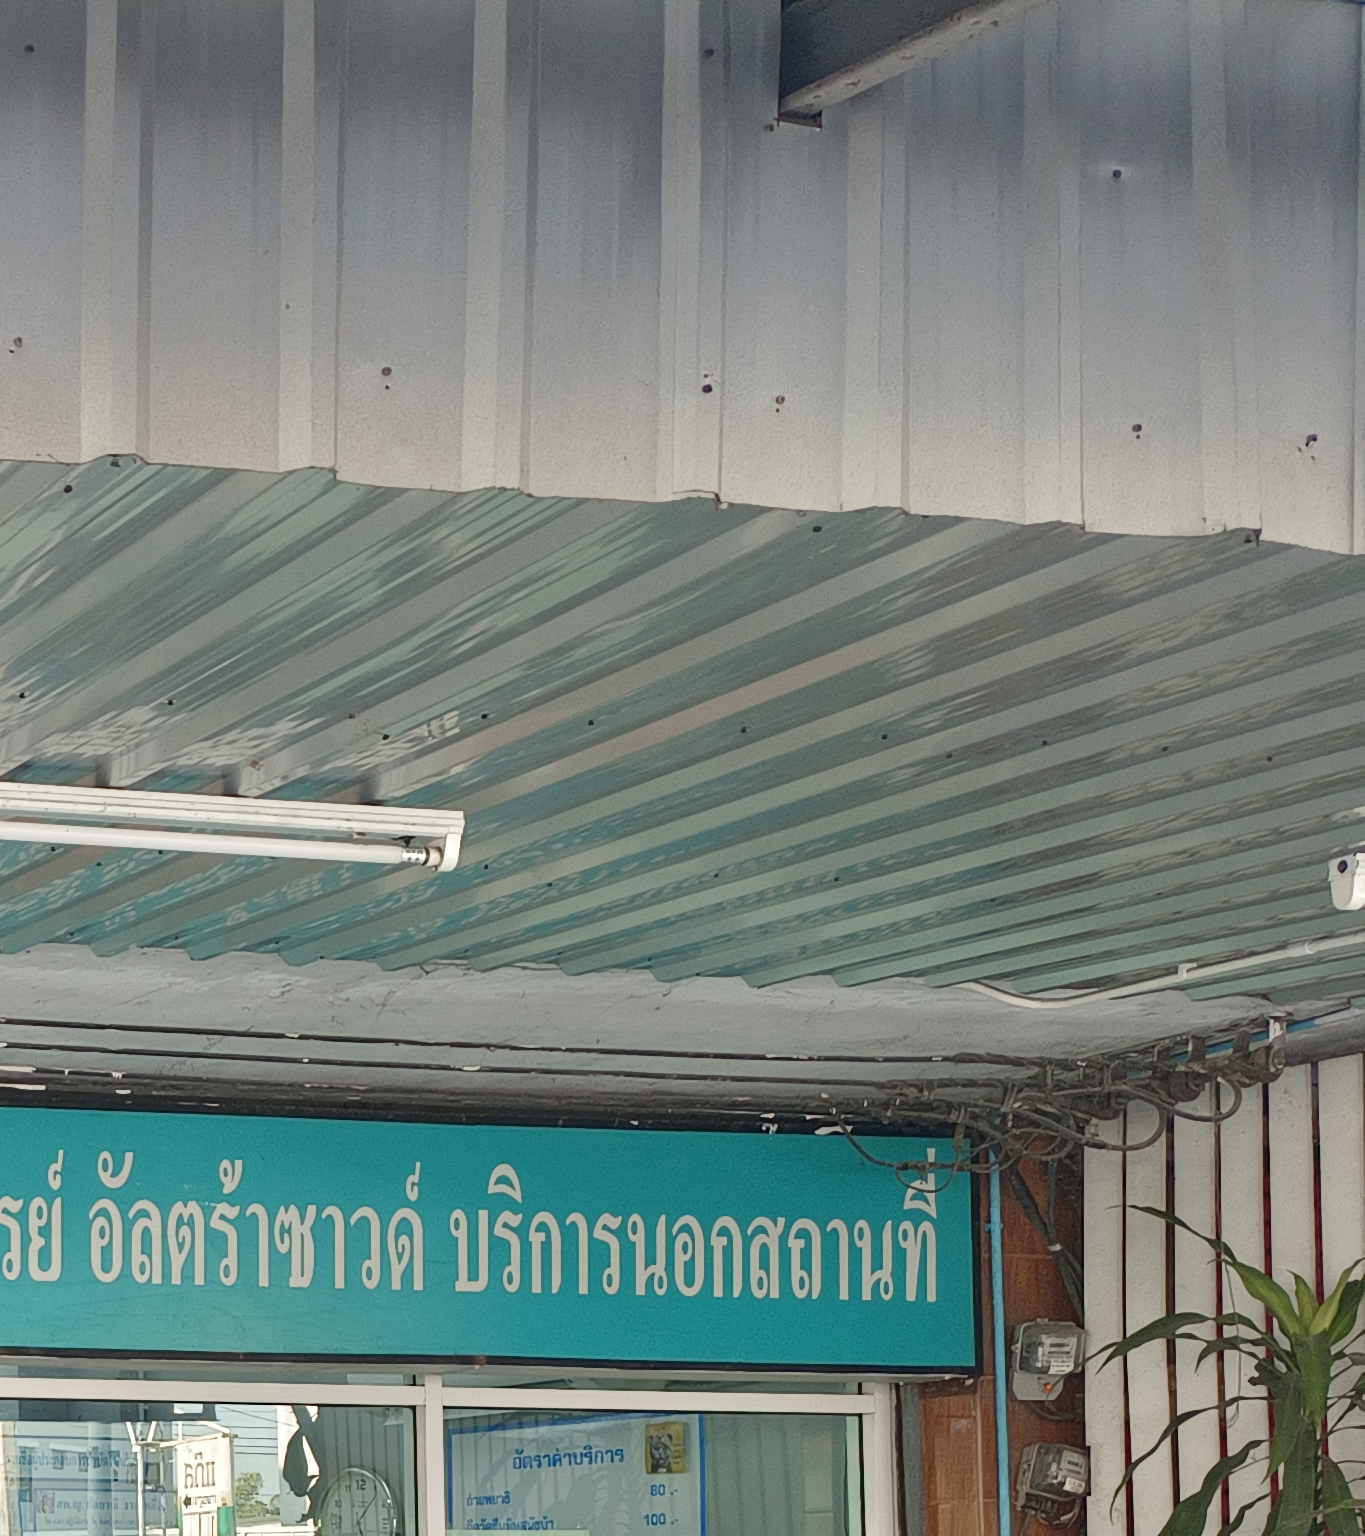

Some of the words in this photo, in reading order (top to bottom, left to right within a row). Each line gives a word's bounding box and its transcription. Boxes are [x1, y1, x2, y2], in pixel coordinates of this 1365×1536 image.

[88, 1150, 424, 1291] อัลตร้าซาวด์
[449, 1147, 937, 1303] บริการนอกสถานที่
[512, 1446, 625, 1469] อัตราค่าบริการ
[650, 1484, 666, 1497] 80
[643, 1513, 667, 1527] 100
